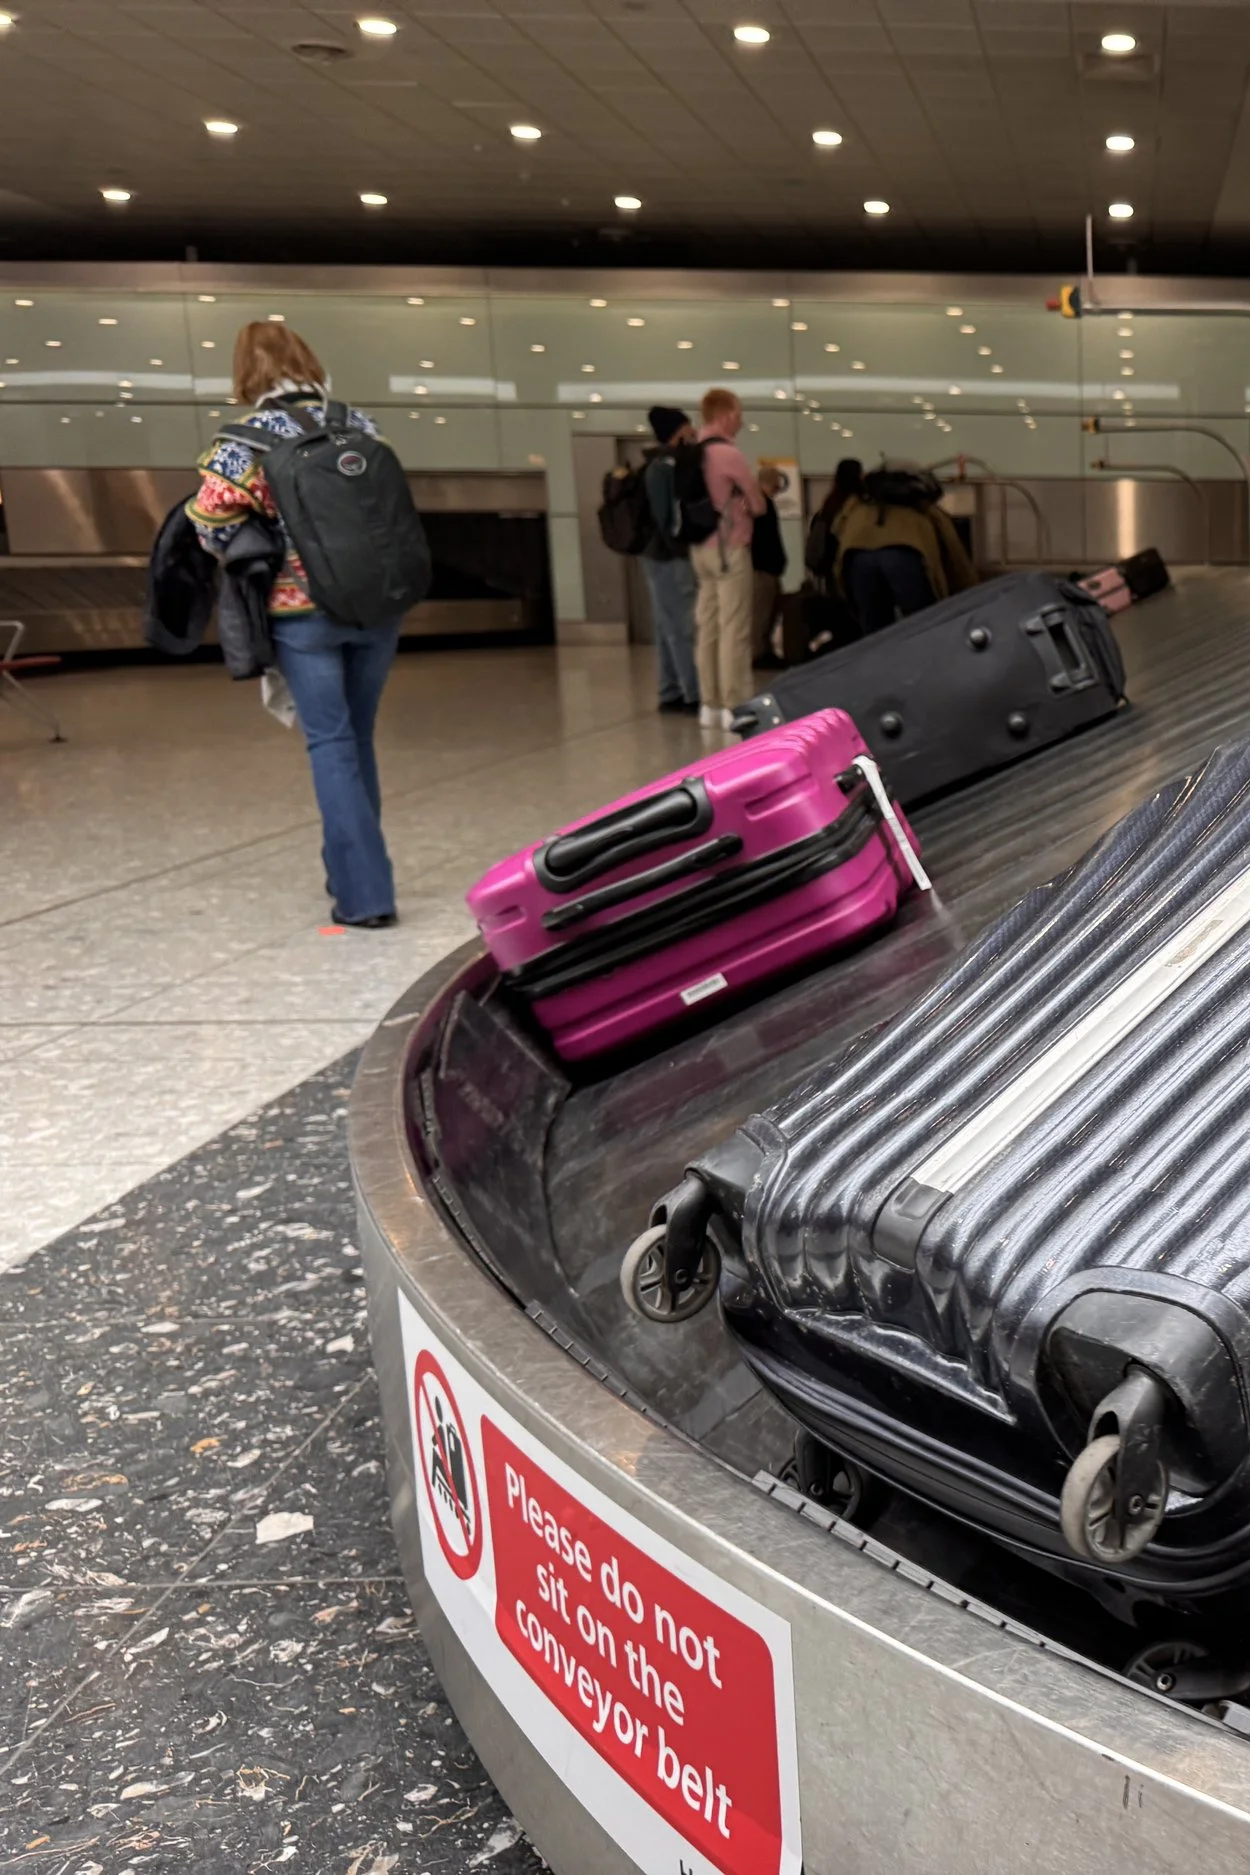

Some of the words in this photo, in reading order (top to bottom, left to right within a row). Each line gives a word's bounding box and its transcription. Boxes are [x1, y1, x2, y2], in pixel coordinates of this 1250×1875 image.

[504, 1462, 592, 1583] Please
[600, 1556, 644, 1625] do
[654, 1602, 723, 1690] not
[536, 1561, 571, 1625] sit
[577, 1604, 617, 1668] on
[624, 1639, 684, 1726] the
[515, 1598, 649, 1759] conveyor
[656, 1724, 733, 1839] belt
